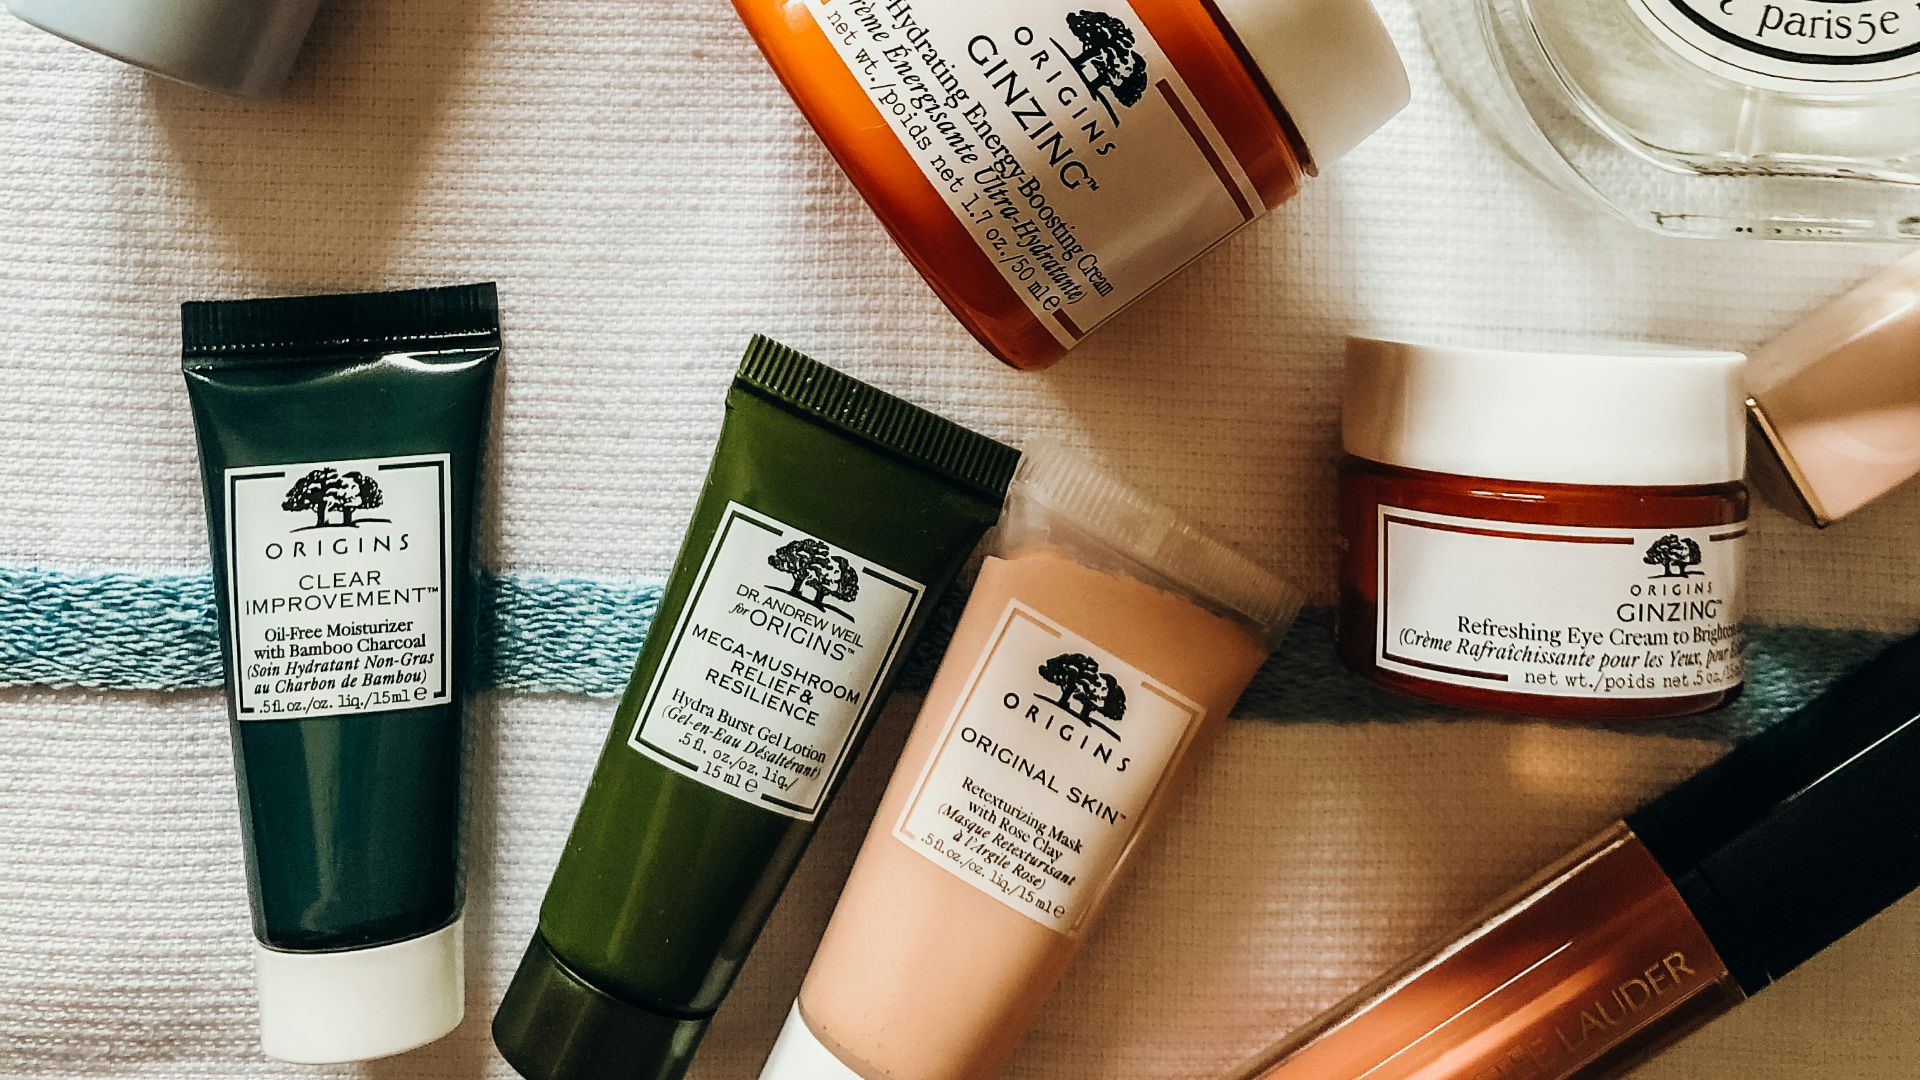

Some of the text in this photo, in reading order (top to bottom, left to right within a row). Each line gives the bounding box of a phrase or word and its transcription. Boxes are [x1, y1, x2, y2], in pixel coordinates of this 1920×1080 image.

[1014, 26, 1116, 155] ORIGINS
[827, 10, 858, 46] net
[855, 48, 932, 150] wt./poids
[930, 154, 965, 193] net
[961, 192, 993, 224] 1.7
[986, 228, 1036, 281] oz./50
[882, 44, 979, 163] Énergisante
[974, 165, 1088, 305] Ultra-Hydratante)
[962, 102, 1084, 261] Energy-Boosting
[1077, 254, 1114, 297] Cream
[265, 533, 409, 559] ORIGINS
[299, 570, 382, 590] CLEAR
[728, 602, 750, 616] for
[1630, 581, 1713, 596] ORIGINS
[254, 633, 426, 659] with Bamboo Charcoal
[264, 619, 414, 642] Oil-Free Moisturizer
[736, 583, 864, 648] DR. ANDREW WEIL
[1457, 615, 1562, 648] Refreshing
[1567, 626, 1604, 649] Eye
[1609, 628, 1668, 646] Cream
[1673, 630, 1690, 645] to
[247, 652, 435, 680] (Soin Hydratant Non-Gras
[692, 623, 861, 705] MEGA-MUSHROOM
[1399, 628, 1453, 652] (Crème
[1456, 638, 1595, 667] Rafraîchissante
[1597, 652, 1641, 672] pour
[1643, 650, 1664, 668] les
[254, 668, 427, 694] au Charbon de Bambou)
[705, 668, 820, 726] RESILIENCE
[1524, 670, 1558, 686] net
[1565, 672, 1656, 692] wt./poids
[1662, 676, 1690, 688] net
[661, 704, 822, 780] (Gel-en-Eau Désaltérant)
[671, 688, 827, 764] Hydra Burst Gel Lotion
[1003, 692, 1131, 773] ORIGINS
[702, 761, 721, 779] 15
[723, 770, 742, 788] ml
[712, 749, 759, 777] oz./oz.
[761, 766, 799, 792] liq./
[960, 726, 1059, 794] ORIGINAL
[937, 802, 1077, 886] (Masque Retexturisant
[961, 776, 1084, 854] Retexturizing Mask
[968, 800, 1064, 864] with Rose Clay
[952, 829, 963, 843] à
[1011, 863, 1046, 890] Rose)
[1556, 951, 1696, 1051] LAUDER
